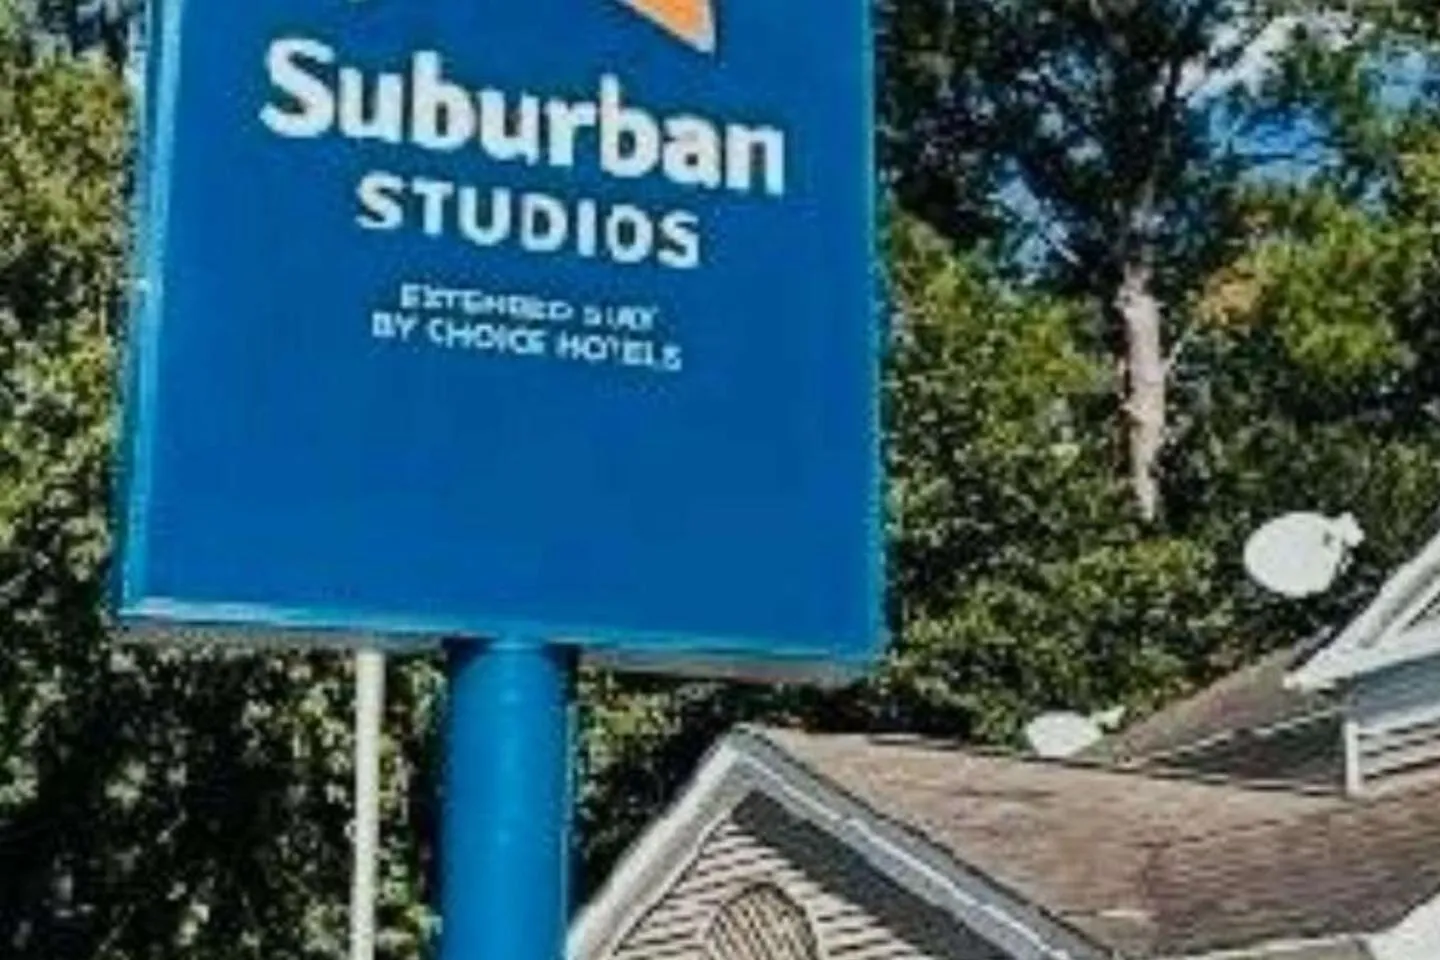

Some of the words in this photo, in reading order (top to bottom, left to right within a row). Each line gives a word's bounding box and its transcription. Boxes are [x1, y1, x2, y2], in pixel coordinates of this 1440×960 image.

[259, 37, 785, 195] Suburban
[356, 171, 701, 269] STUDIOS
[372, 310, 418, 341] BY
[425, 317, 546, 355] CHOICE
[556, 331, 682, 371] HOTELS
